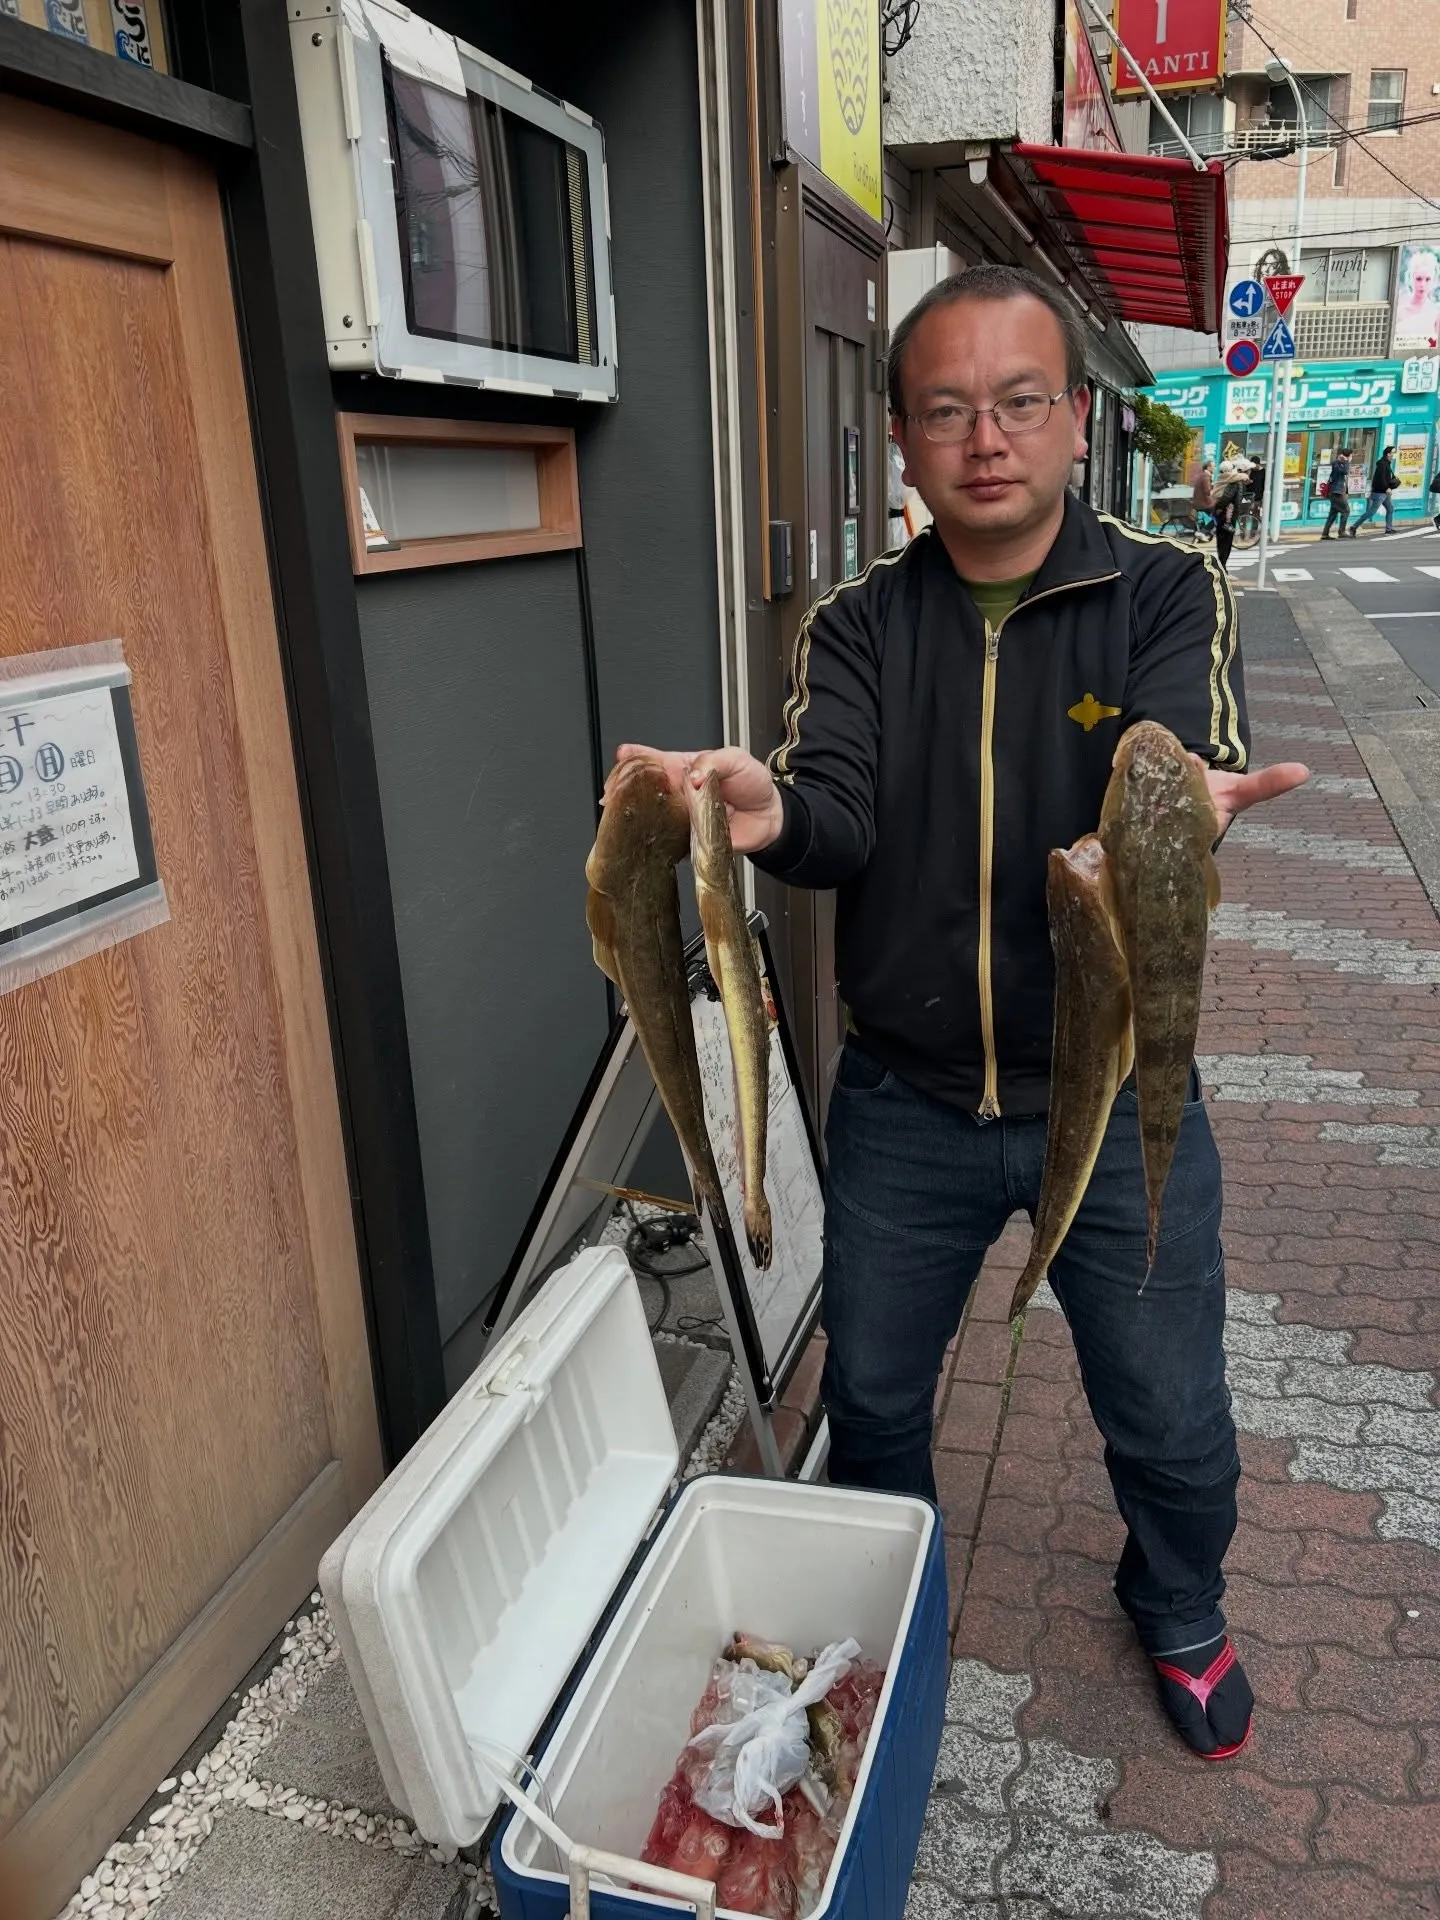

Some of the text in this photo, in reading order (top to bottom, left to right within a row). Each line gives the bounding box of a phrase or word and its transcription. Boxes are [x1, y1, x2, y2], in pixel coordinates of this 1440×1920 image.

[1272, 279, 1297, 290] 止まれ
[1275, 290, 1293, 300] STOP
[1234, 328, 1257, 337] 8-20
[1149, 385, 1210, 407] ニング
[1232, 385, 1260, 398] RITZ
